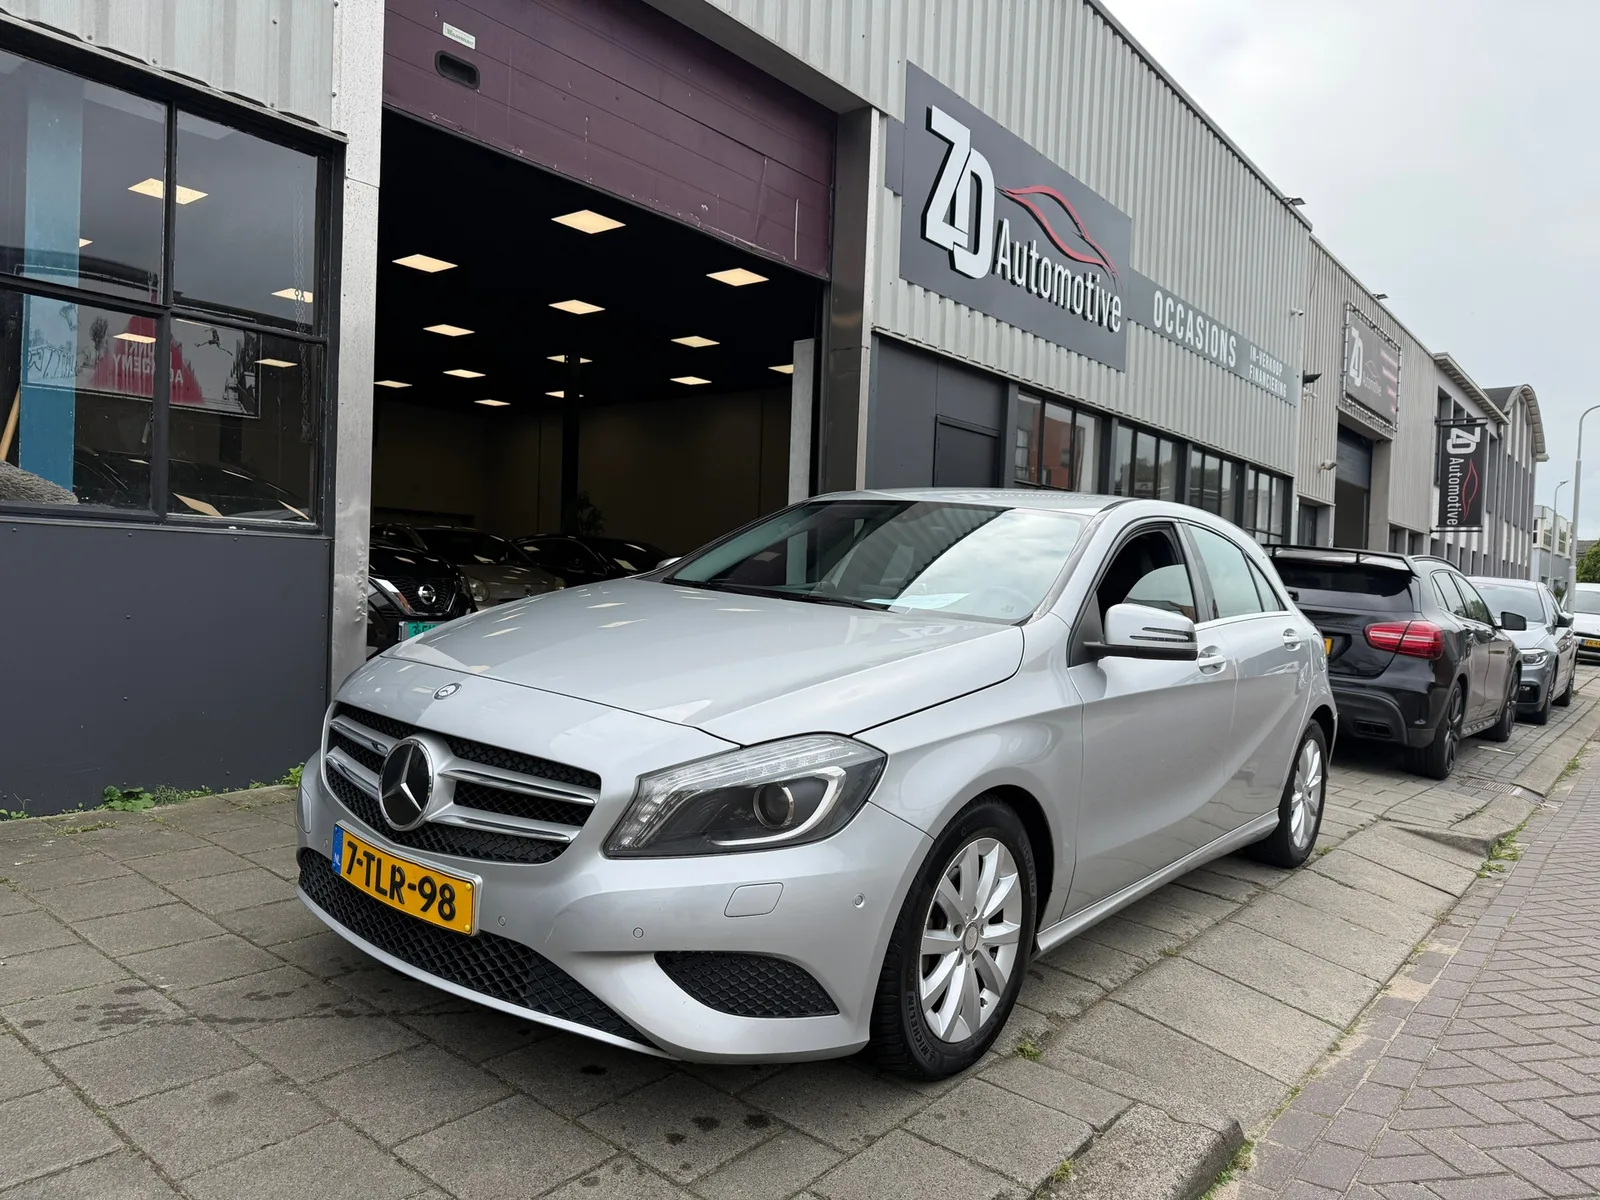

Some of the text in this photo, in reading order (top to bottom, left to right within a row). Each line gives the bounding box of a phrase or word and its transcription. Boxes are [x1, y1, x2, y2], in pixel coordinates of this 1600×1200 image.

[996, 217, 1122, 333] Automotive
[1153, 290, 1237, 368] OCCASIONS
[1249, 363, 1287, 398] FINANCIERING
[1446, 457, 1465, 526] Automotive
[346, 840, 457, 921] 7-TLR-98
[907, 995, 931, 1056] MICHELIN
